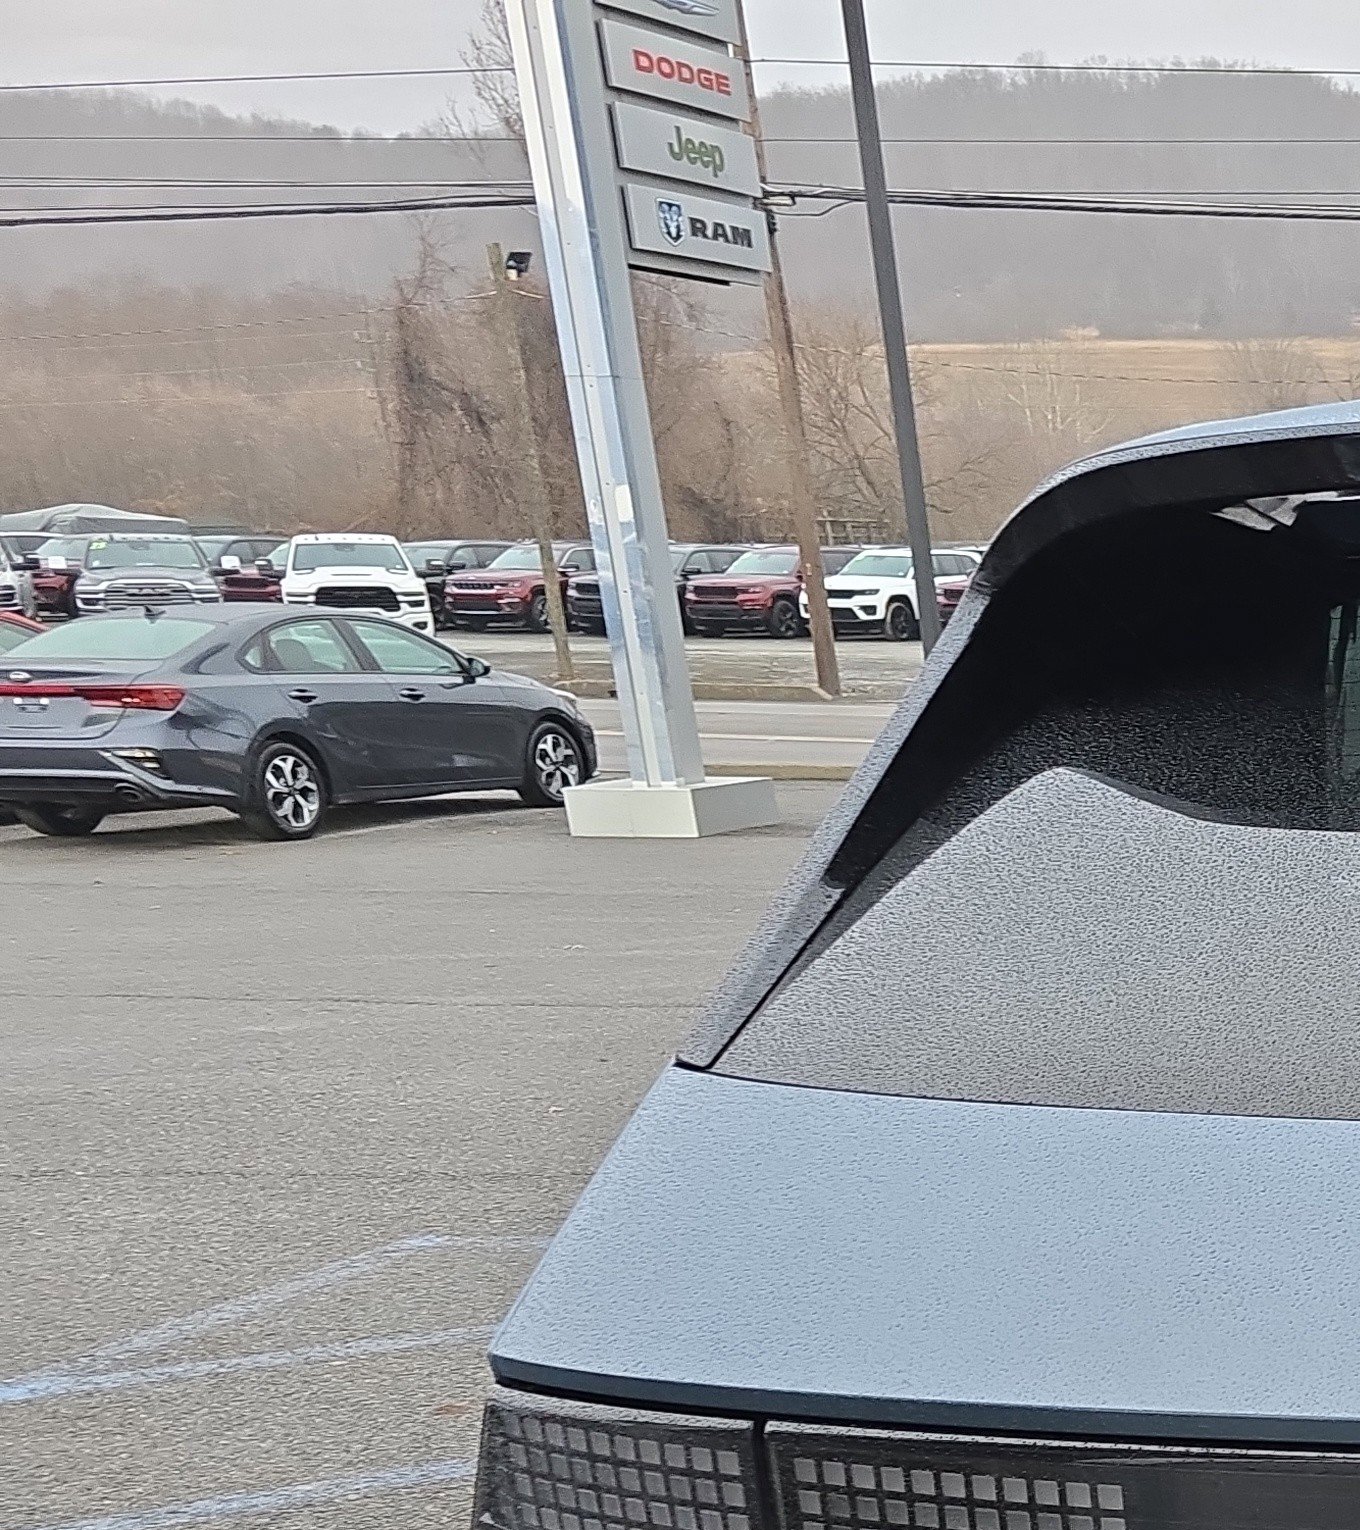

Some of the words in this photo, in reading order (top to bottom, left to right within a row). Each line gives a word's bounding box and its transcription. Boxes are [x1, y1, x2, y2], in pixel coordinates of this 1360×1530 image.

[632, 48, 732, 96] DODGE
[666, 125, 725, 178] Jeep
[688, 217, 753, 249] RAM
